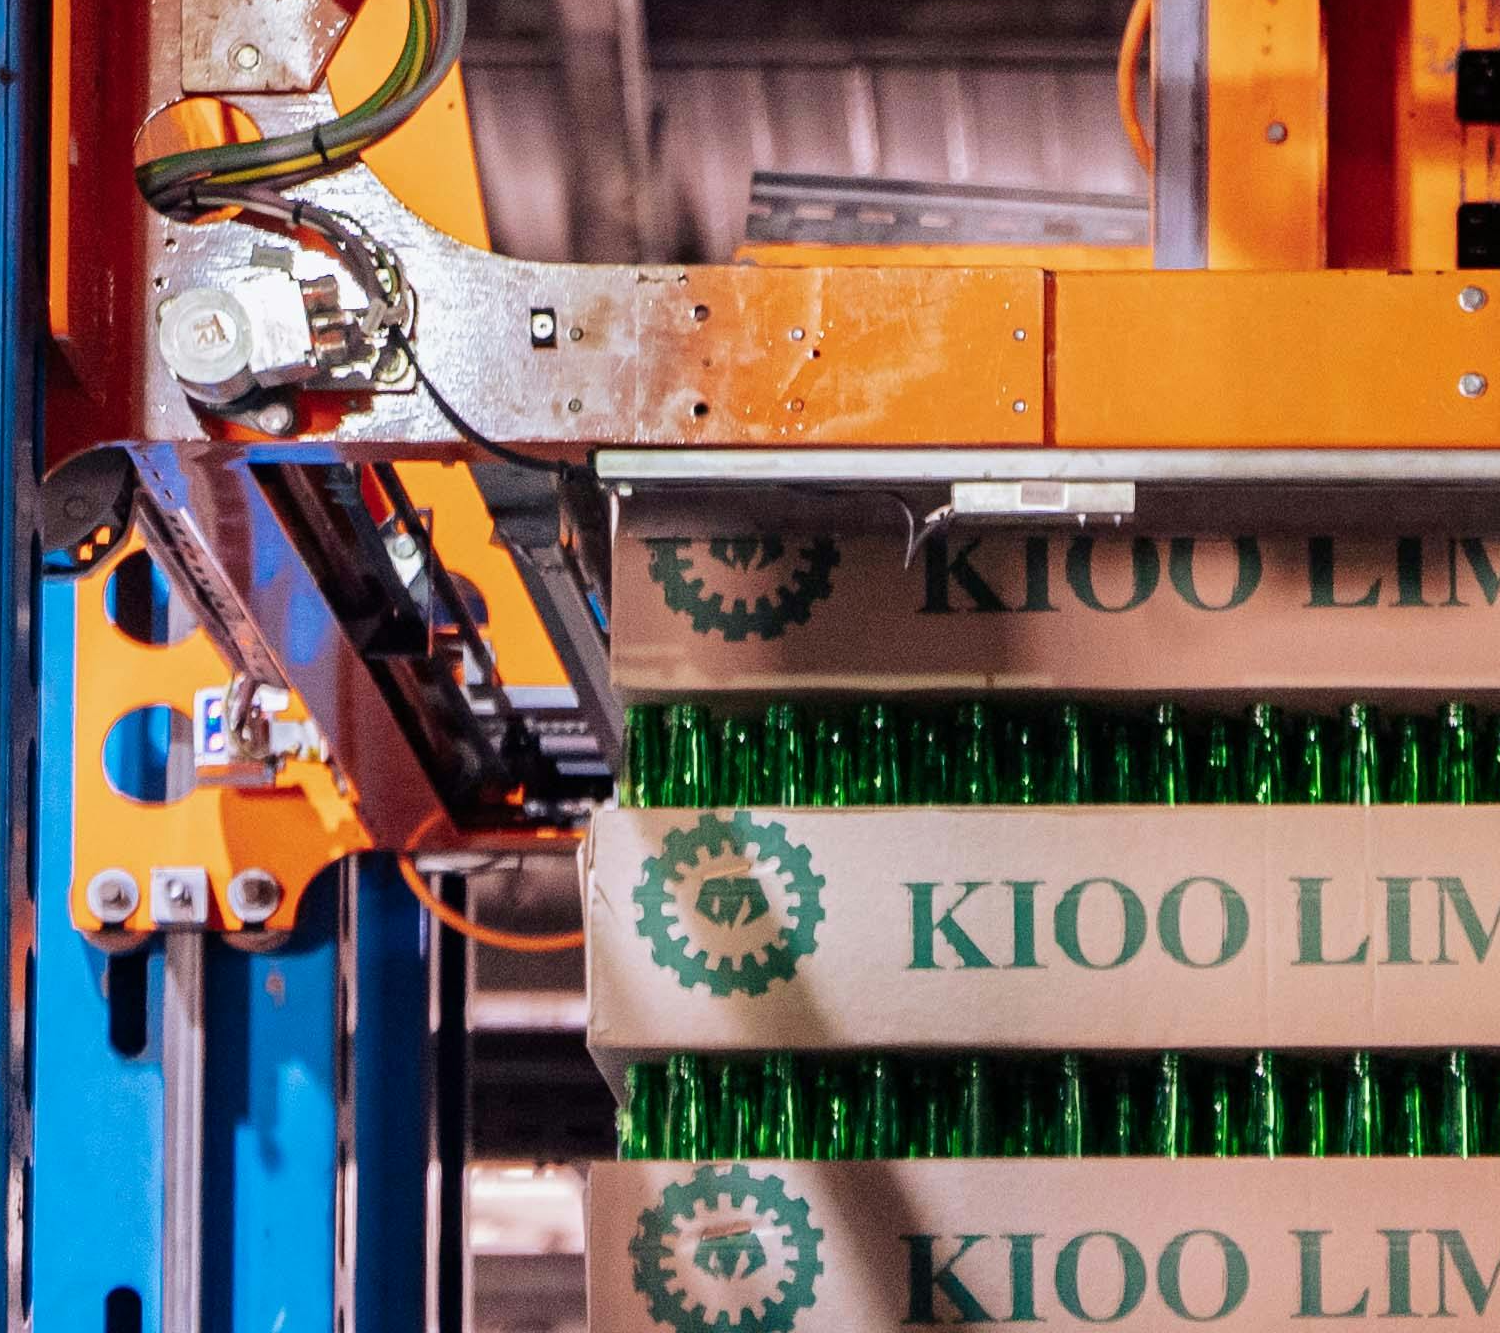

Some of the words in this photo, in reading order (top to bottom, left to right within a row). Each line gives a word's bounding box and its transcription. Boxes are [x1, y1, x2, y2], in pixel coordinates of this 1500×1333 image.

[916, 536, 1262, 614] KIOO
[902, 875, 1252, 973] KIOO
[901, 1228, 1252, 1326] KIOO
